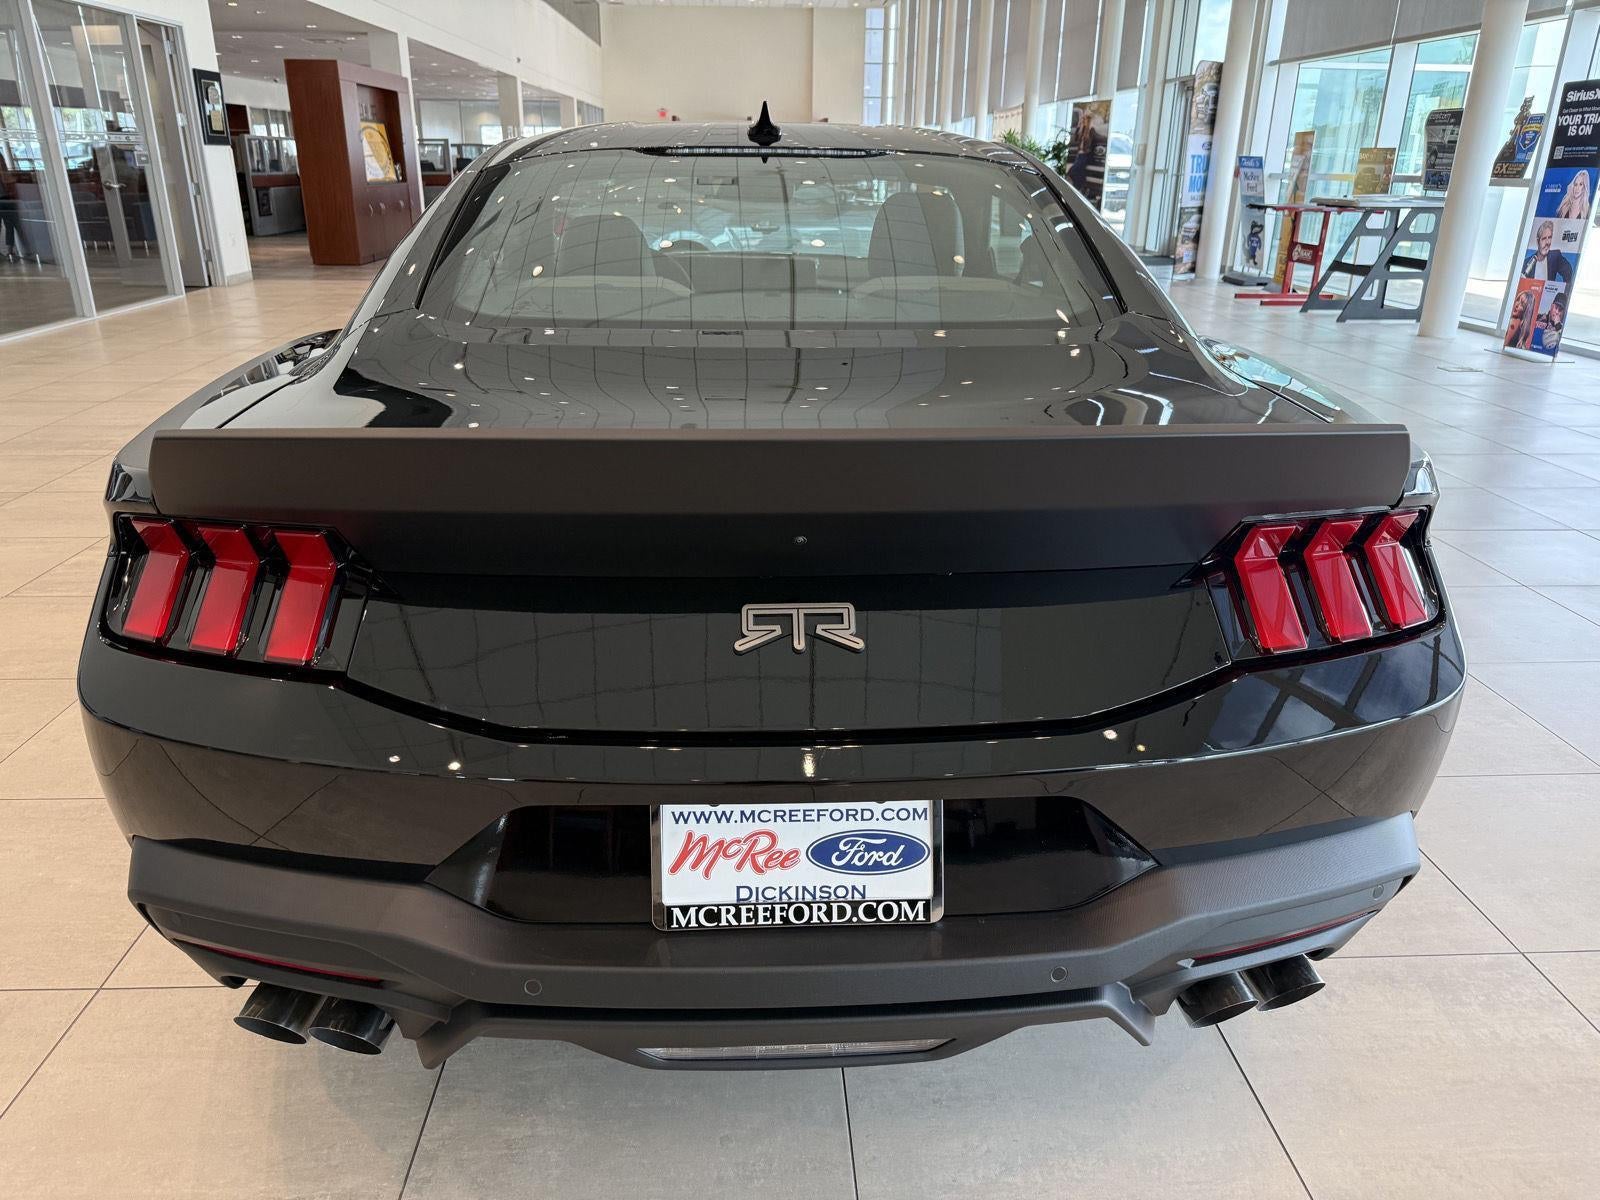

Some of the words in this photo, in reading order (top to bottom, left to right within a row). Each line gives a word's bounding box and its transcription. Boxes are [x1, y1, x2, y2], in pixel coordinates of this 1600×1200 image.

[1558, 114, 1582, 126] YOUR
[1568, 126, 1577, 136] IS
[1578, 124, 1593, 136] ON
[671, 807, 928, 825] WWW.MCREEFORD.COM
[668, 829, 801, 880] McRee
[831, 836, 905, 866] Ford
[670, 900, 926, 928] MCREEFORD.COM
